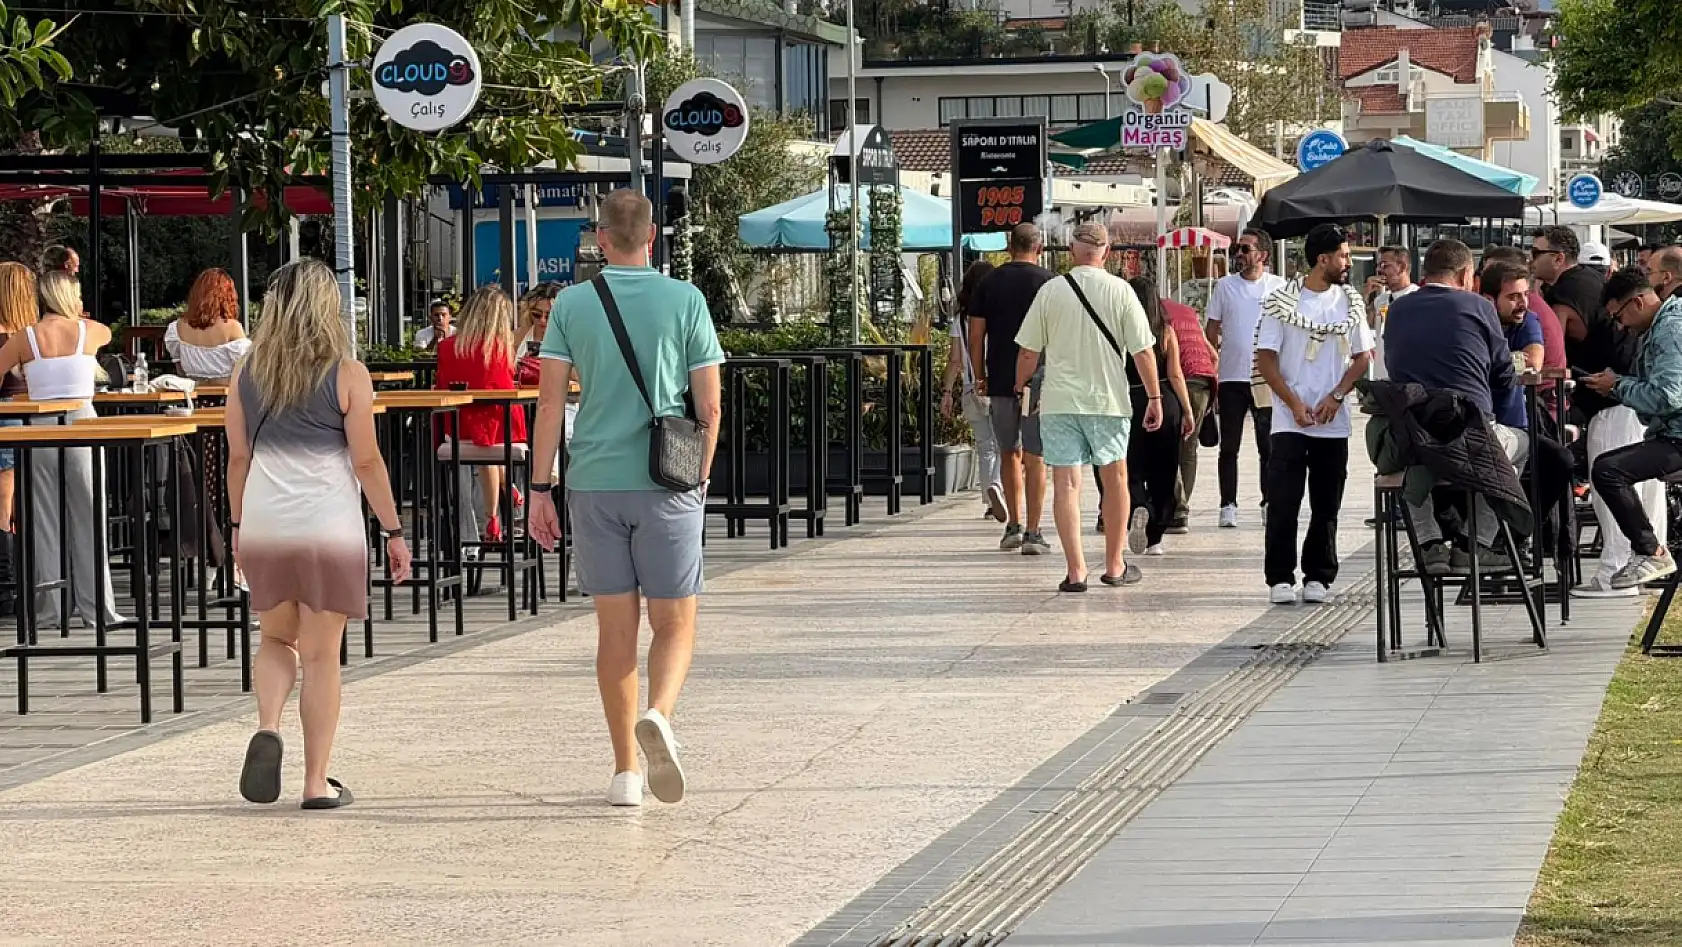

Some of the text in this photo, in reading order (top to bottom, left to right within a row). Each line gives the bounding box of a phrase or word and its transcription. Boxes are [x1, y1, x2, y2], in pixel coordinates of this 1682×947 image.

[411, 101, 446, 118] Çalış
[1126, 110, 1188, 129] Organic
[962, 135, 1037, 147] SAPORI D'ITALIA
[1124, 127, 1182, 148] Maraş
[693, 140, 722, 154] Çalış
[977, 186, 1026, 207] 1905
[981, 206, 1023, 226] PUB
[529, 257, 570, 274] ASH
